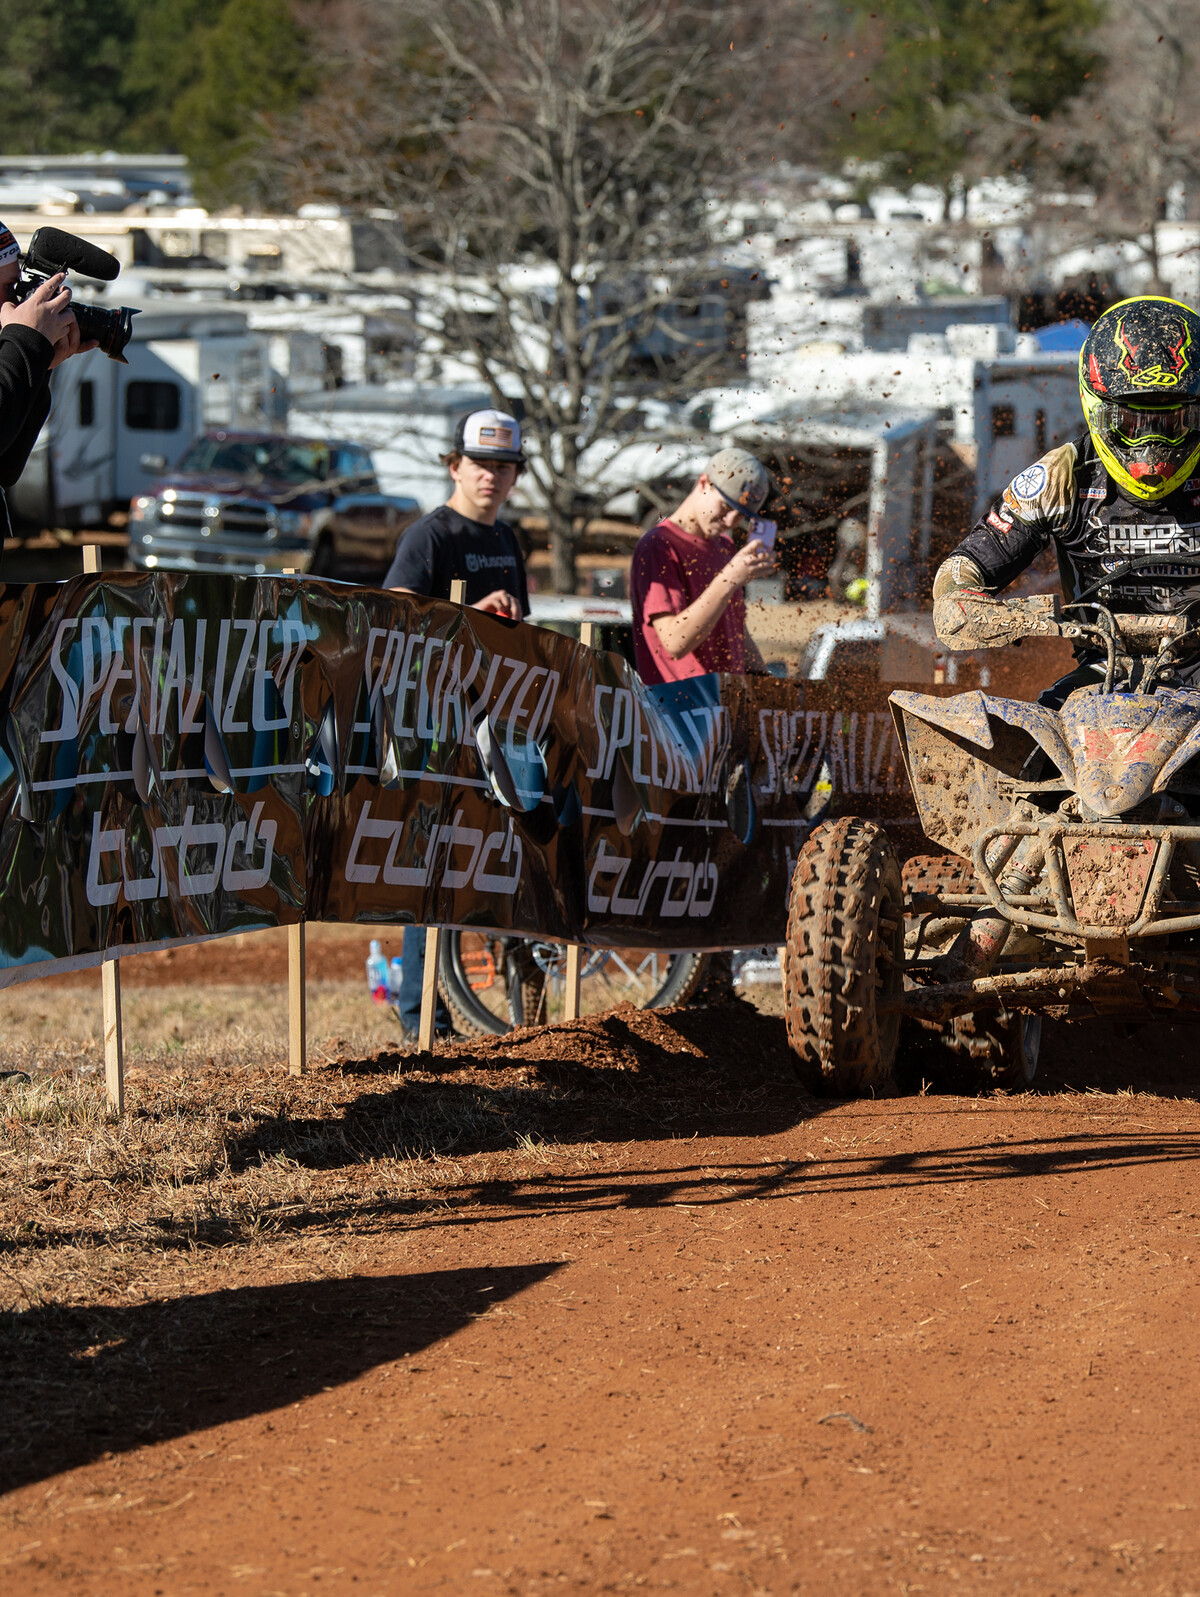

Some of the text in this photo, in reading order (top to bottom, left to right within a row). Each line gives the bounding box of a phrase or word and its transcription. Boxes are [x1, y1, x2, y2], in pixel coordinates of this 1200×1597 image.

[41, 617, 306, 743] SPECIALIZED
[353, 627, 560, 763] SPECIALIZED
[86, 801, 278, 906] turbo
[345, 800, 522, 894] turbo
[588, 838, 718, 917] turbo
